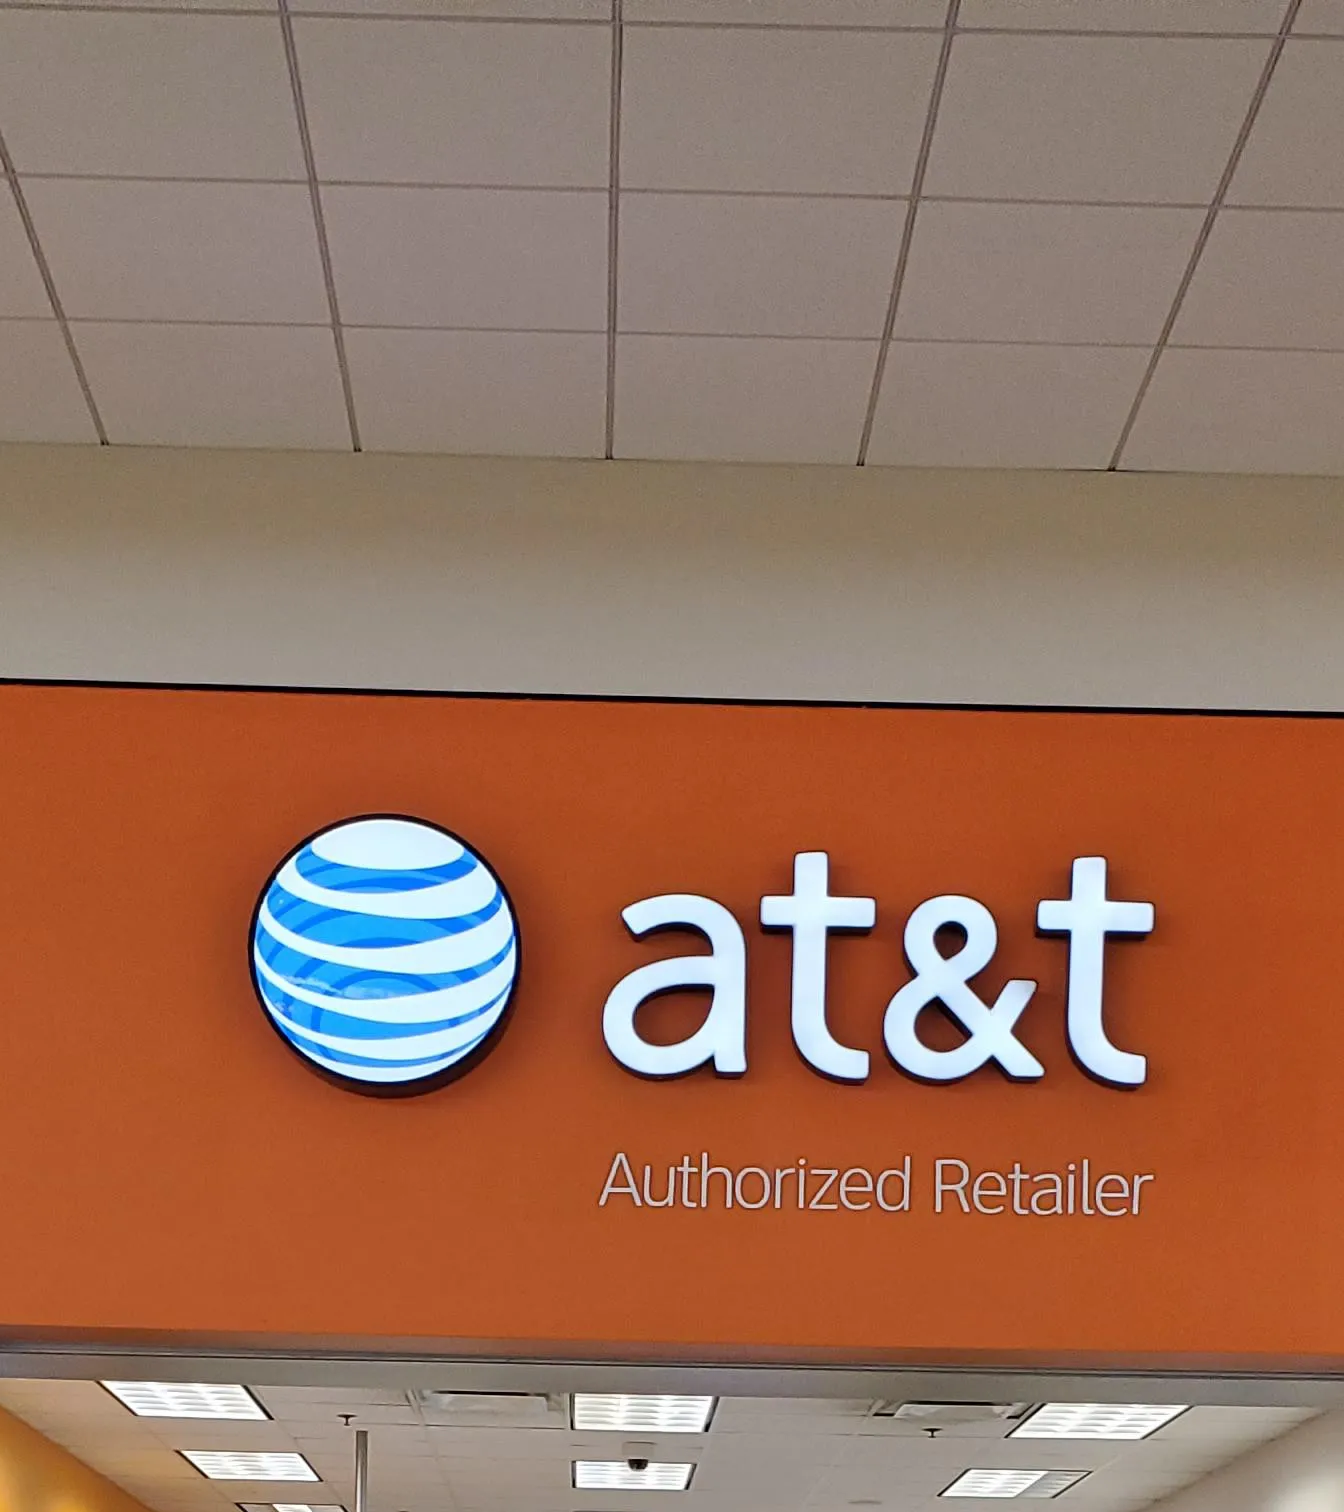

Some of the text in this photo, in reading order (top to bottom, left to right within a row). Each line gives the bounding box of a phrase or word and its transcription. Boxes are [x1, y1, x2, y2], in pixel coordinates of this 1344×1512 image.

[601, 850, 1155, 1088] at&t
[598, 1151, 1155, 1217] Authorized Retailer
